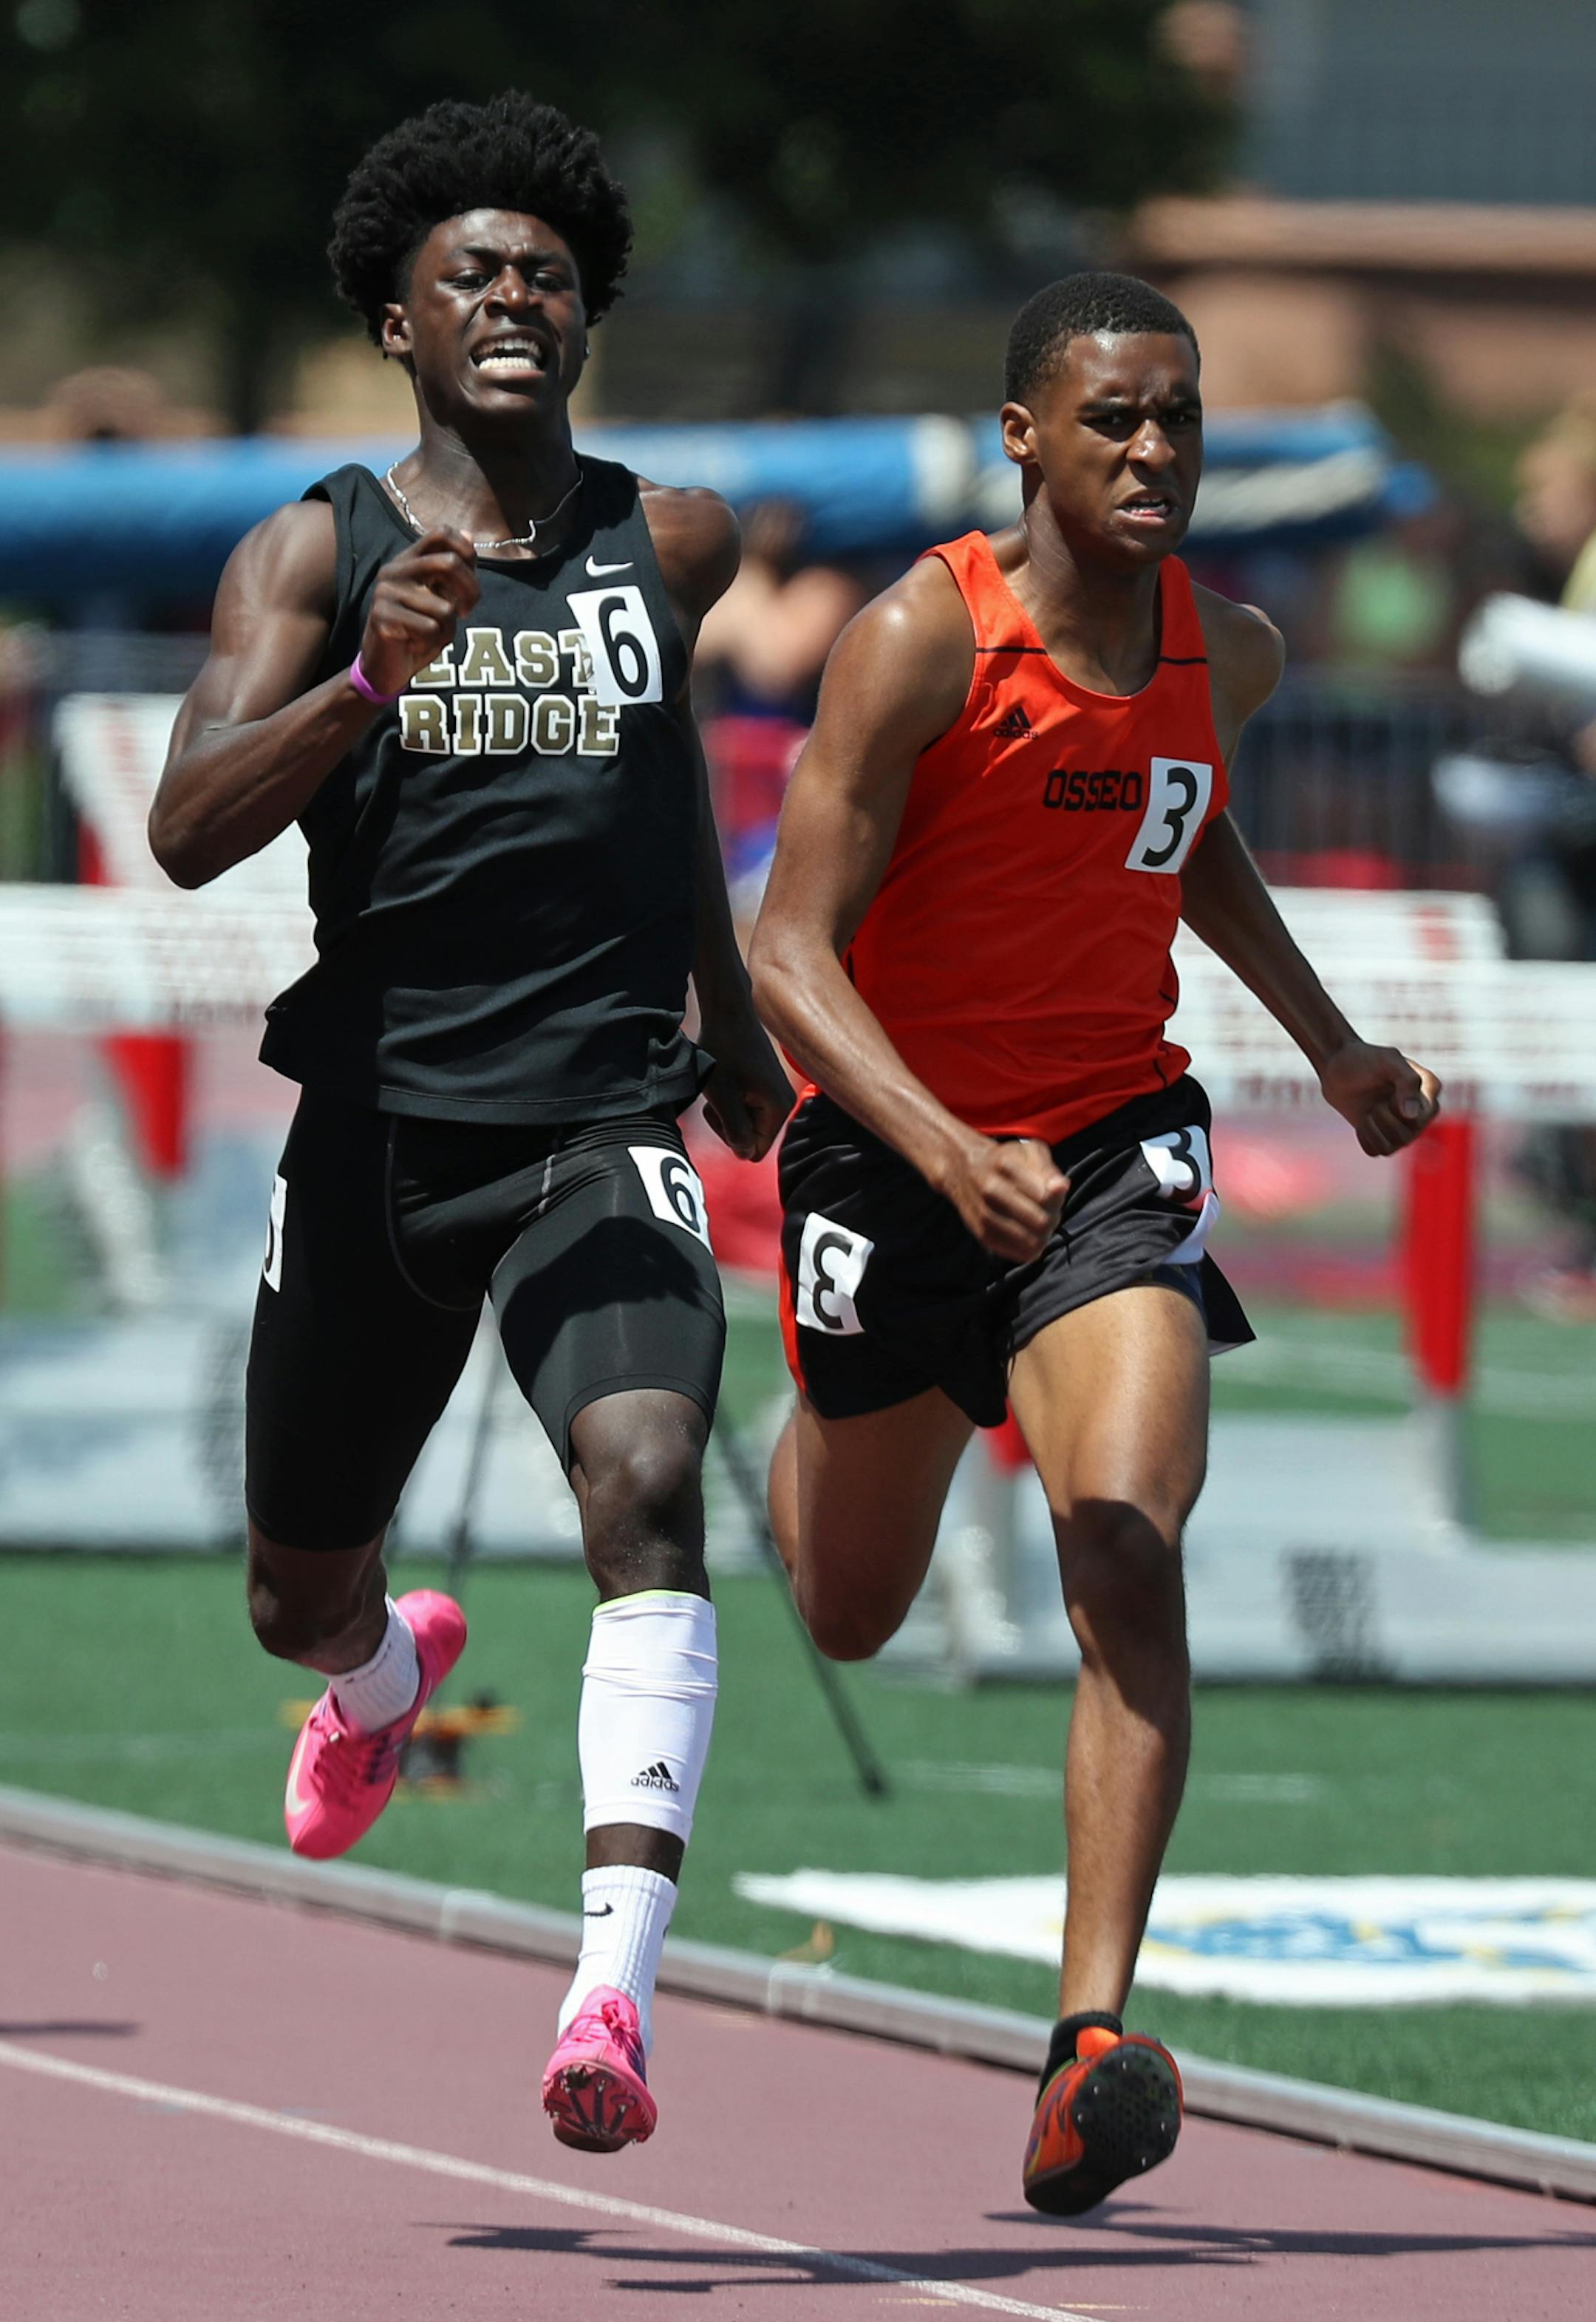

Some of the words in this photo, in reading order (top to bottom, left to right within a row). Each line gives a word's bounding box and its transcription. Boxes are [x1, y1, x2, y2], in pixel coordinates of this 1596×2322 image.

[598, 596, 649, 697] 6
[399, 694, 621, 756] RIDGE
[1043, 769, 1143, 811] OSSEO
[1141, 766, 1197, 867] 3
[661, 1157, 700, 1233] 6
[1166, 1128, 1201, 1203] 3
[630, 1773, 680, 1791] adidas
